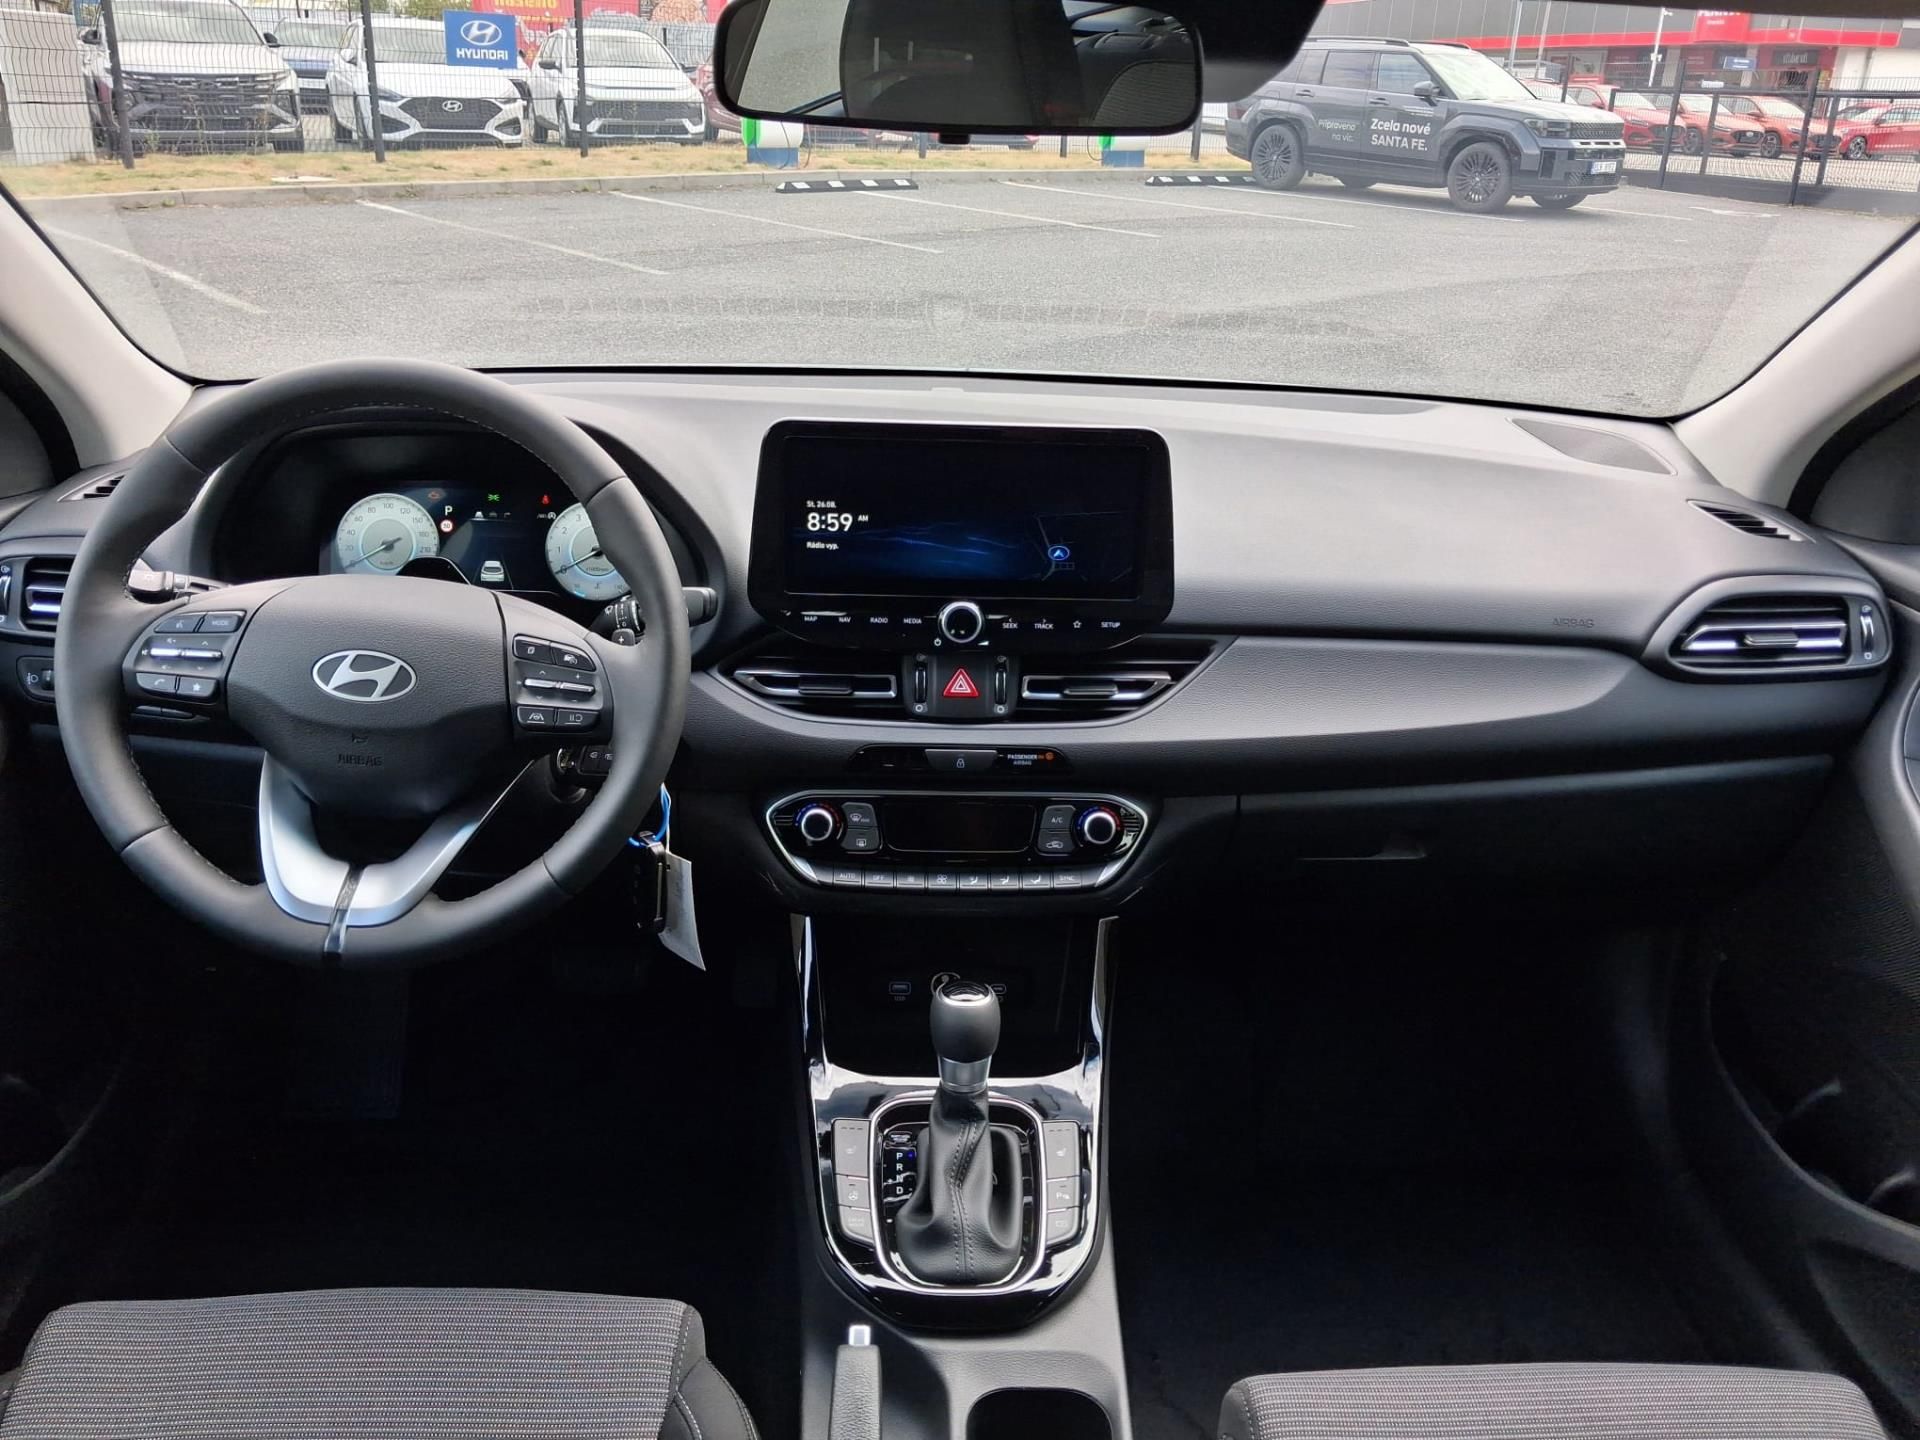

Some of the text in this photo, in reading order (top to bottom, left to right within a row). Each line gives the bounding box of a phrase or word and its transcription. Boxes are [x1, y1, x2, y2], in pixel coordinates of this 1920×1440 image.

[456, 47, 508, 61] HYUNDAI
[1370, 118, 1431, 136] Zcela nové
[1371, 134, 1428, 151] SANTA FE.
[444, 505, 453, 516] P
[807, 512, 853, 532] 8:59
[561, 526, 568, 534] 2
[896, 1152, 904, 1160] P
[896, 1163, 904, 1171] R
[896, 1186, 904, 1195] D
